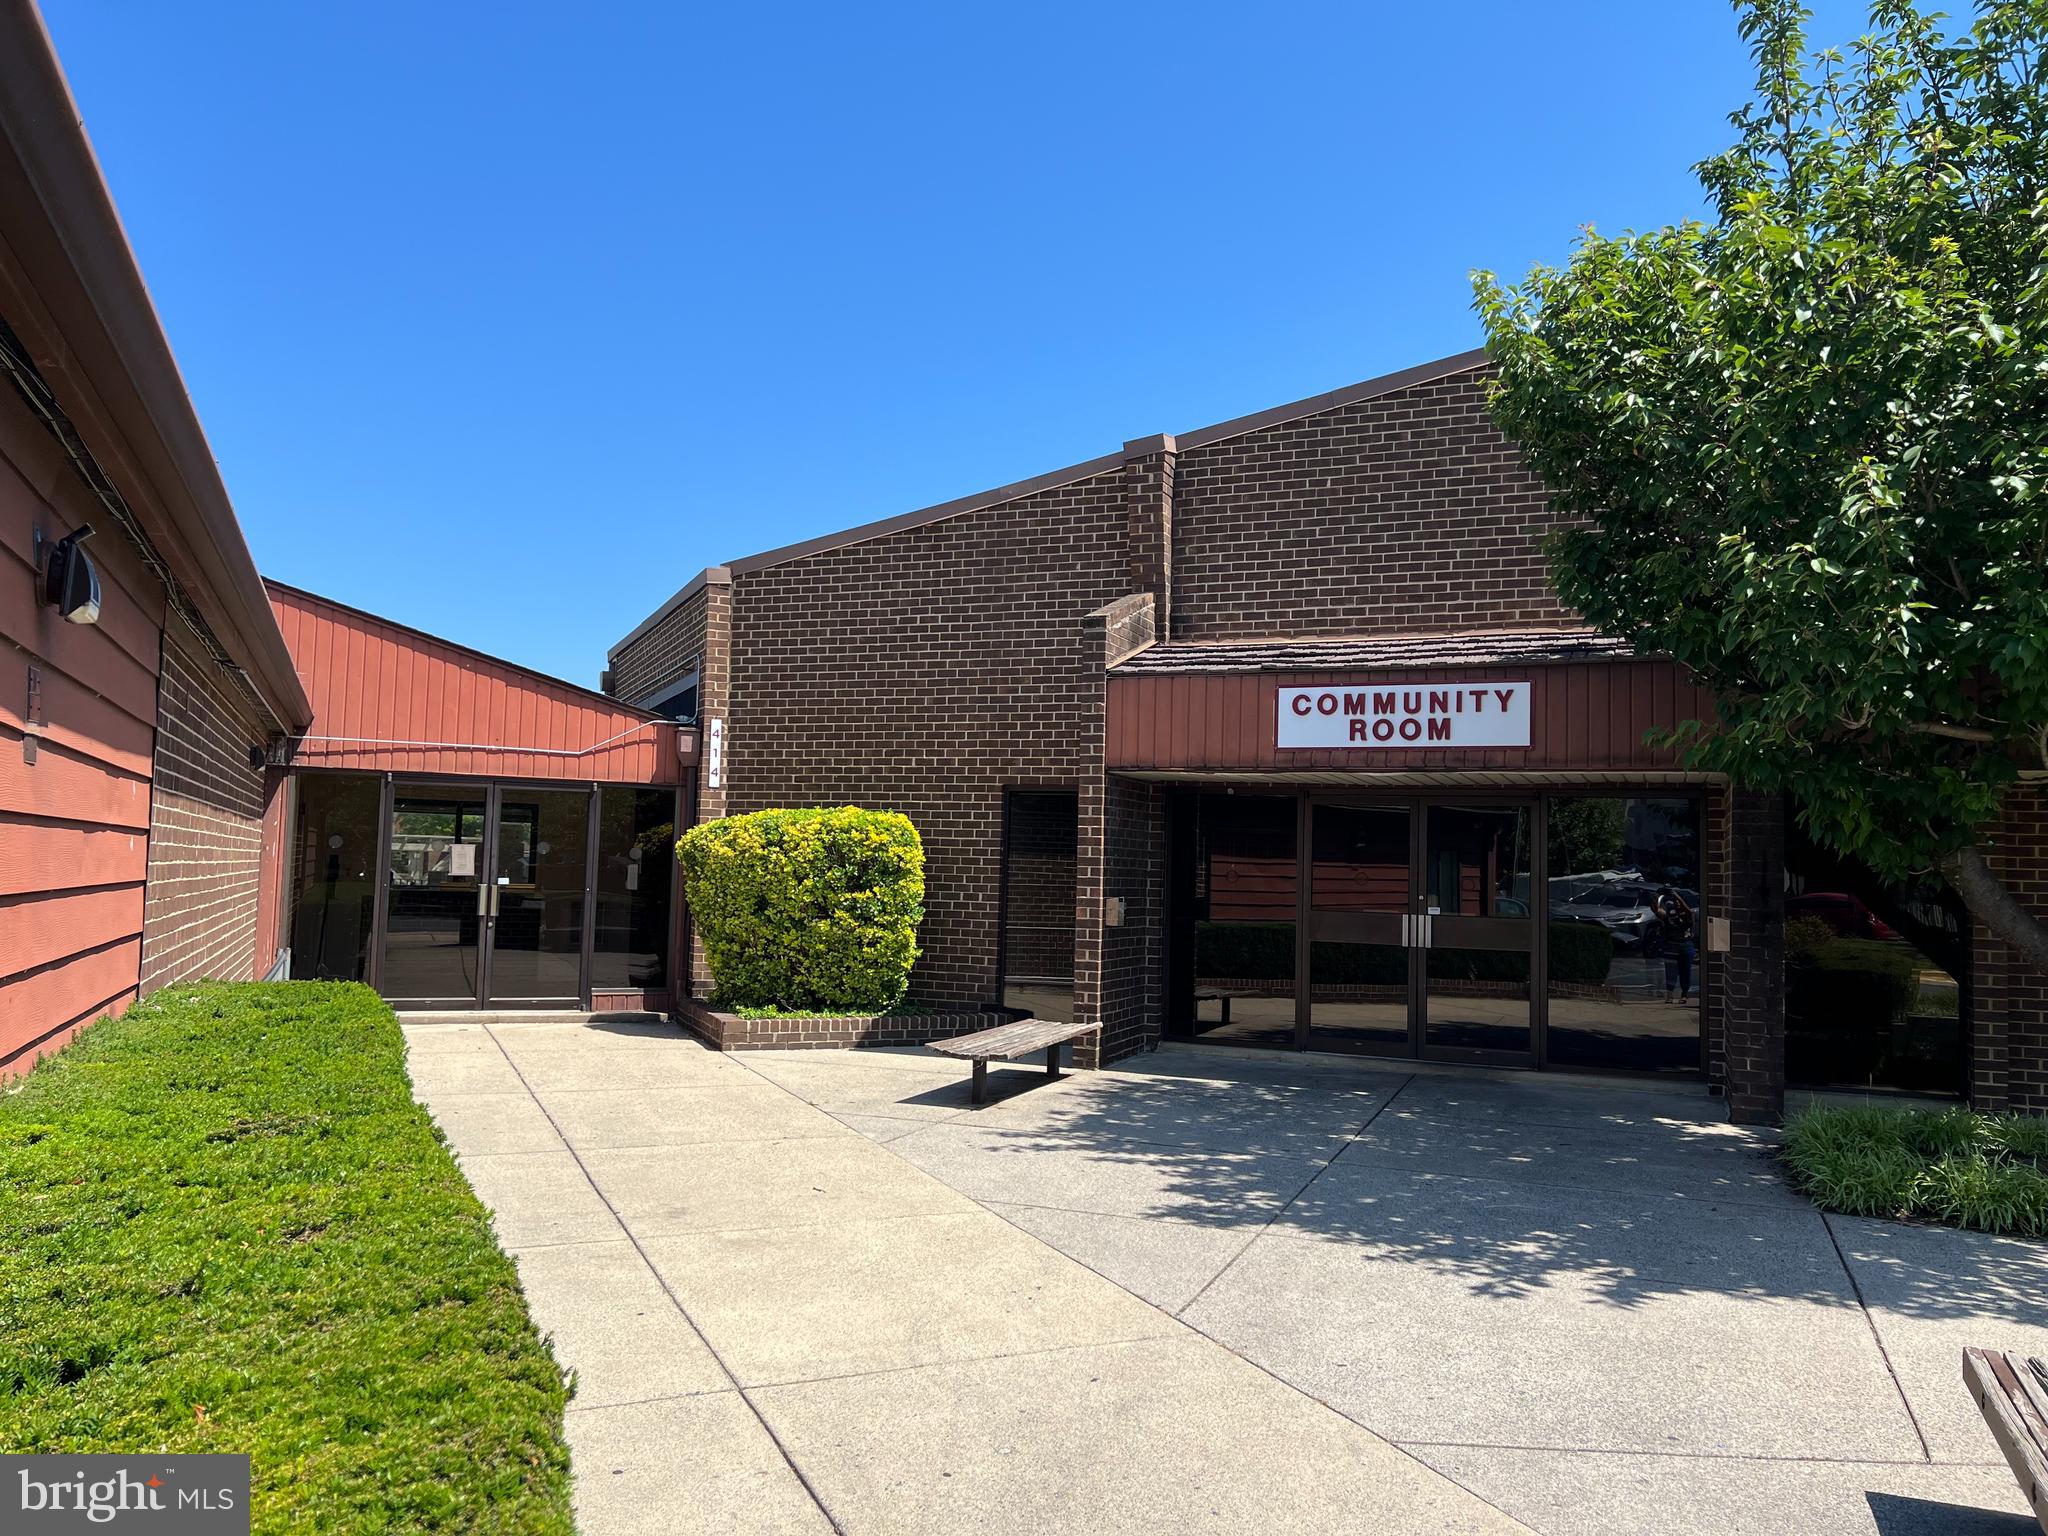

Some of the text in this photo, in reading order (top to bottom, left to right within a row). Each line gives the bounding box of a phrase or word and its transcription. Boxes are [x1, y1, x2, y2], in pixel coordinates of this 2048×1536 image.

[1291, 689, 1514, 716] COMMUNITY
[1349, 718, 1451, 742] ROOM
[711, 729, 720, 777] 414
